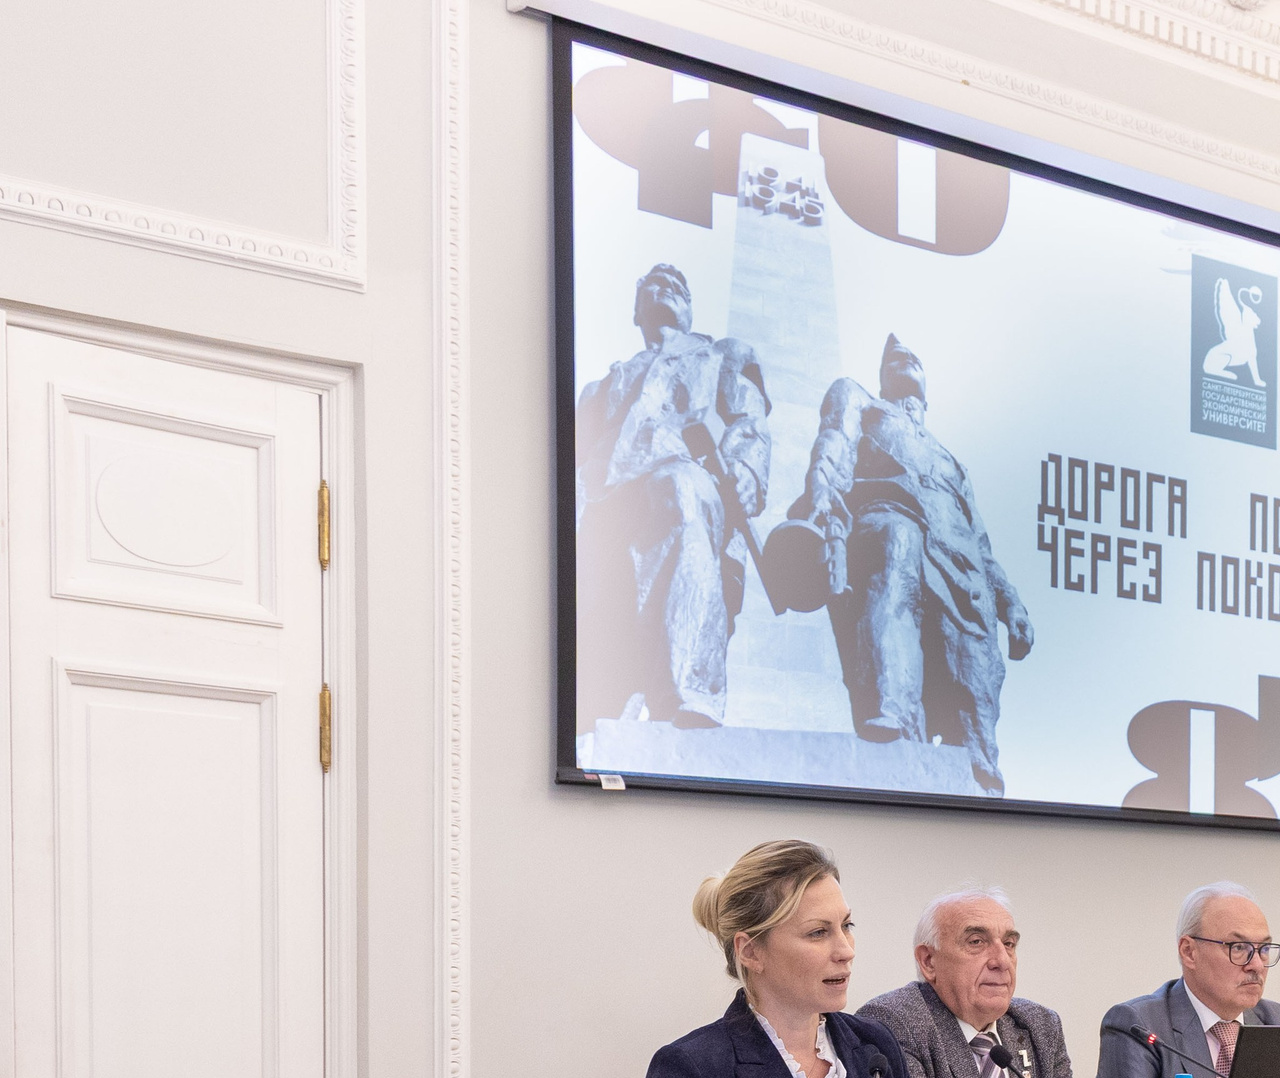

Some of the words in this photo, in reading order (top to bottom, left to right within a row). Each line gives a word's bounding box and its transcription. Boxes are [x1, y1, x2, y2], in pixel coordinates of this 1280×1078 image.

[743, 181, 825, 224] 1945
[1202, 390, 1267, 412] ГОСУДАРСТВЕННЫЙ
[1202, 399, 1267, 421] ЭКОНОМИЧЕСКИЙ
[1202, 409, 1267, 433] УНИВЕРСИТЕТ
[1038, 453, 1187, 539] ДОРОГА
[1038, 523, 1162, 604] ЧЕРЕЗ
